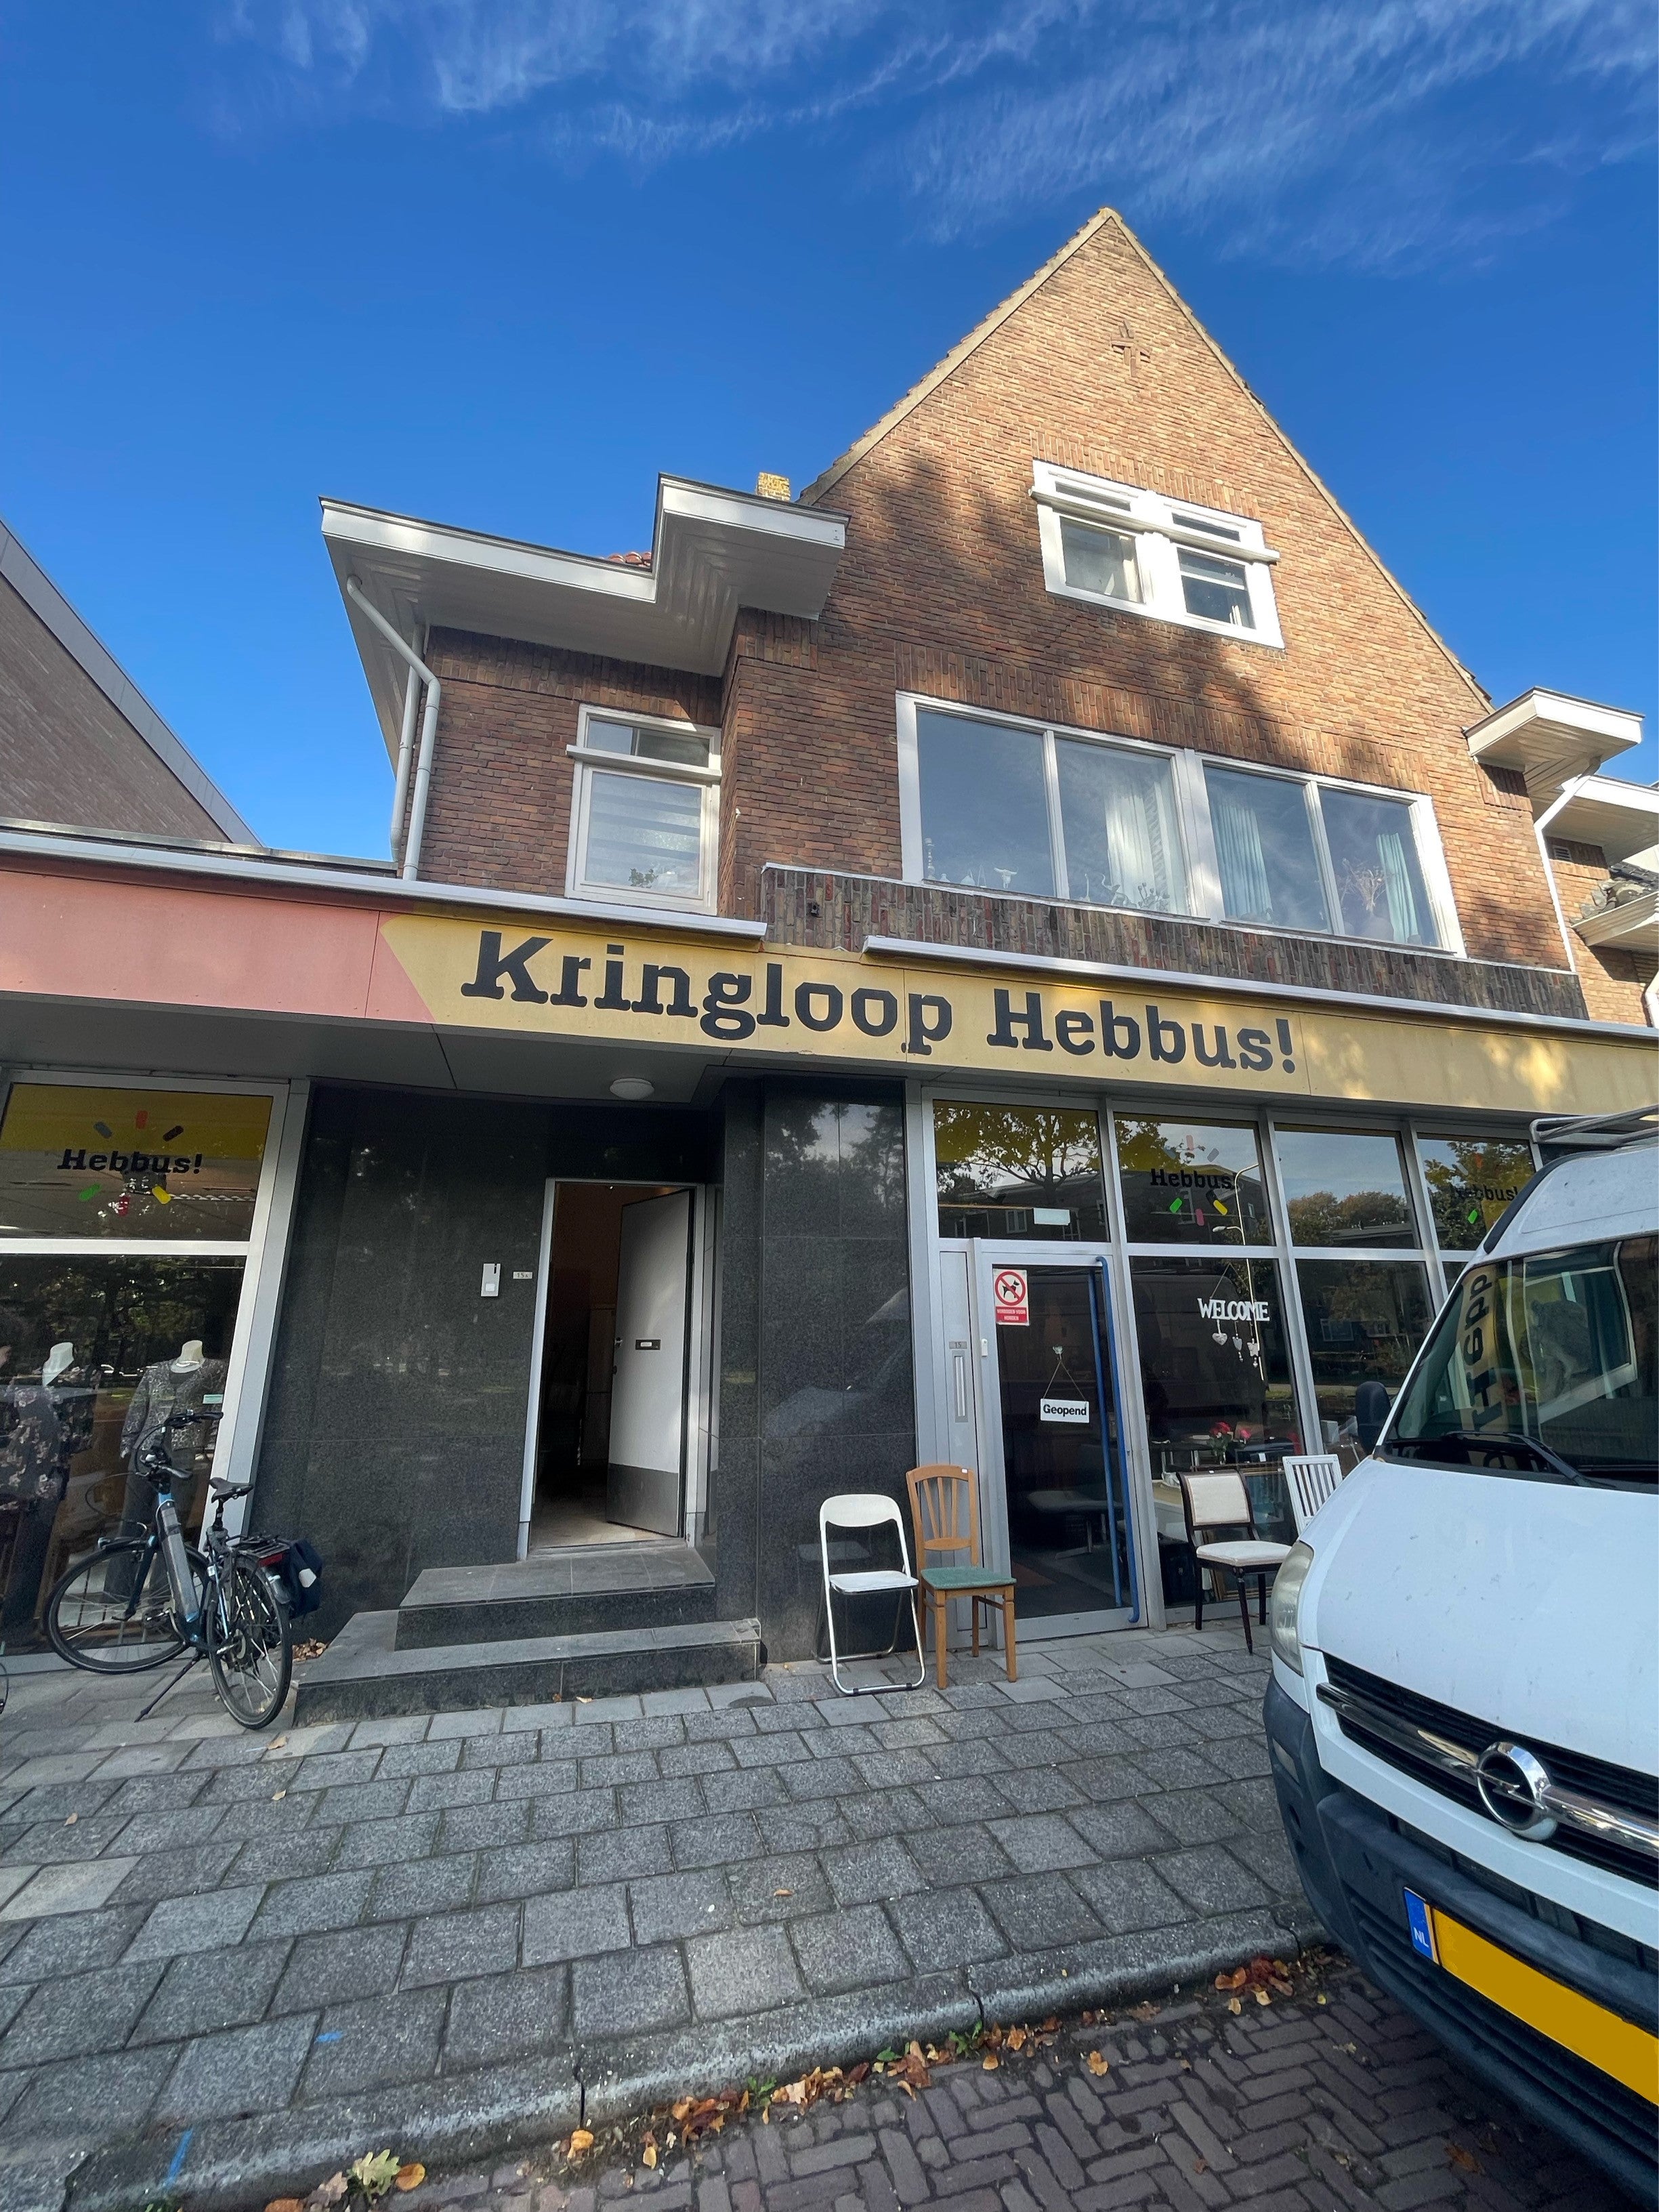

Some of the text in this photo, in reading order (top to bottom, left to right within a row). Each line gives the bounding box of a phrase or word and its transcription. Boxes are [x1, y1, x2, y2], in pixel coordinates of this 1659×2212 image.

[461, 930, 1296, 1074] Kringloop Hebbus!
[57, 1148, 203, 1175] Hebbus!
[1197, 1297, 1270, 1321] WELCOME
[1043, 1404, 1087, 1417] Geopend
[1413, 1927, 1429, 1948] NL
